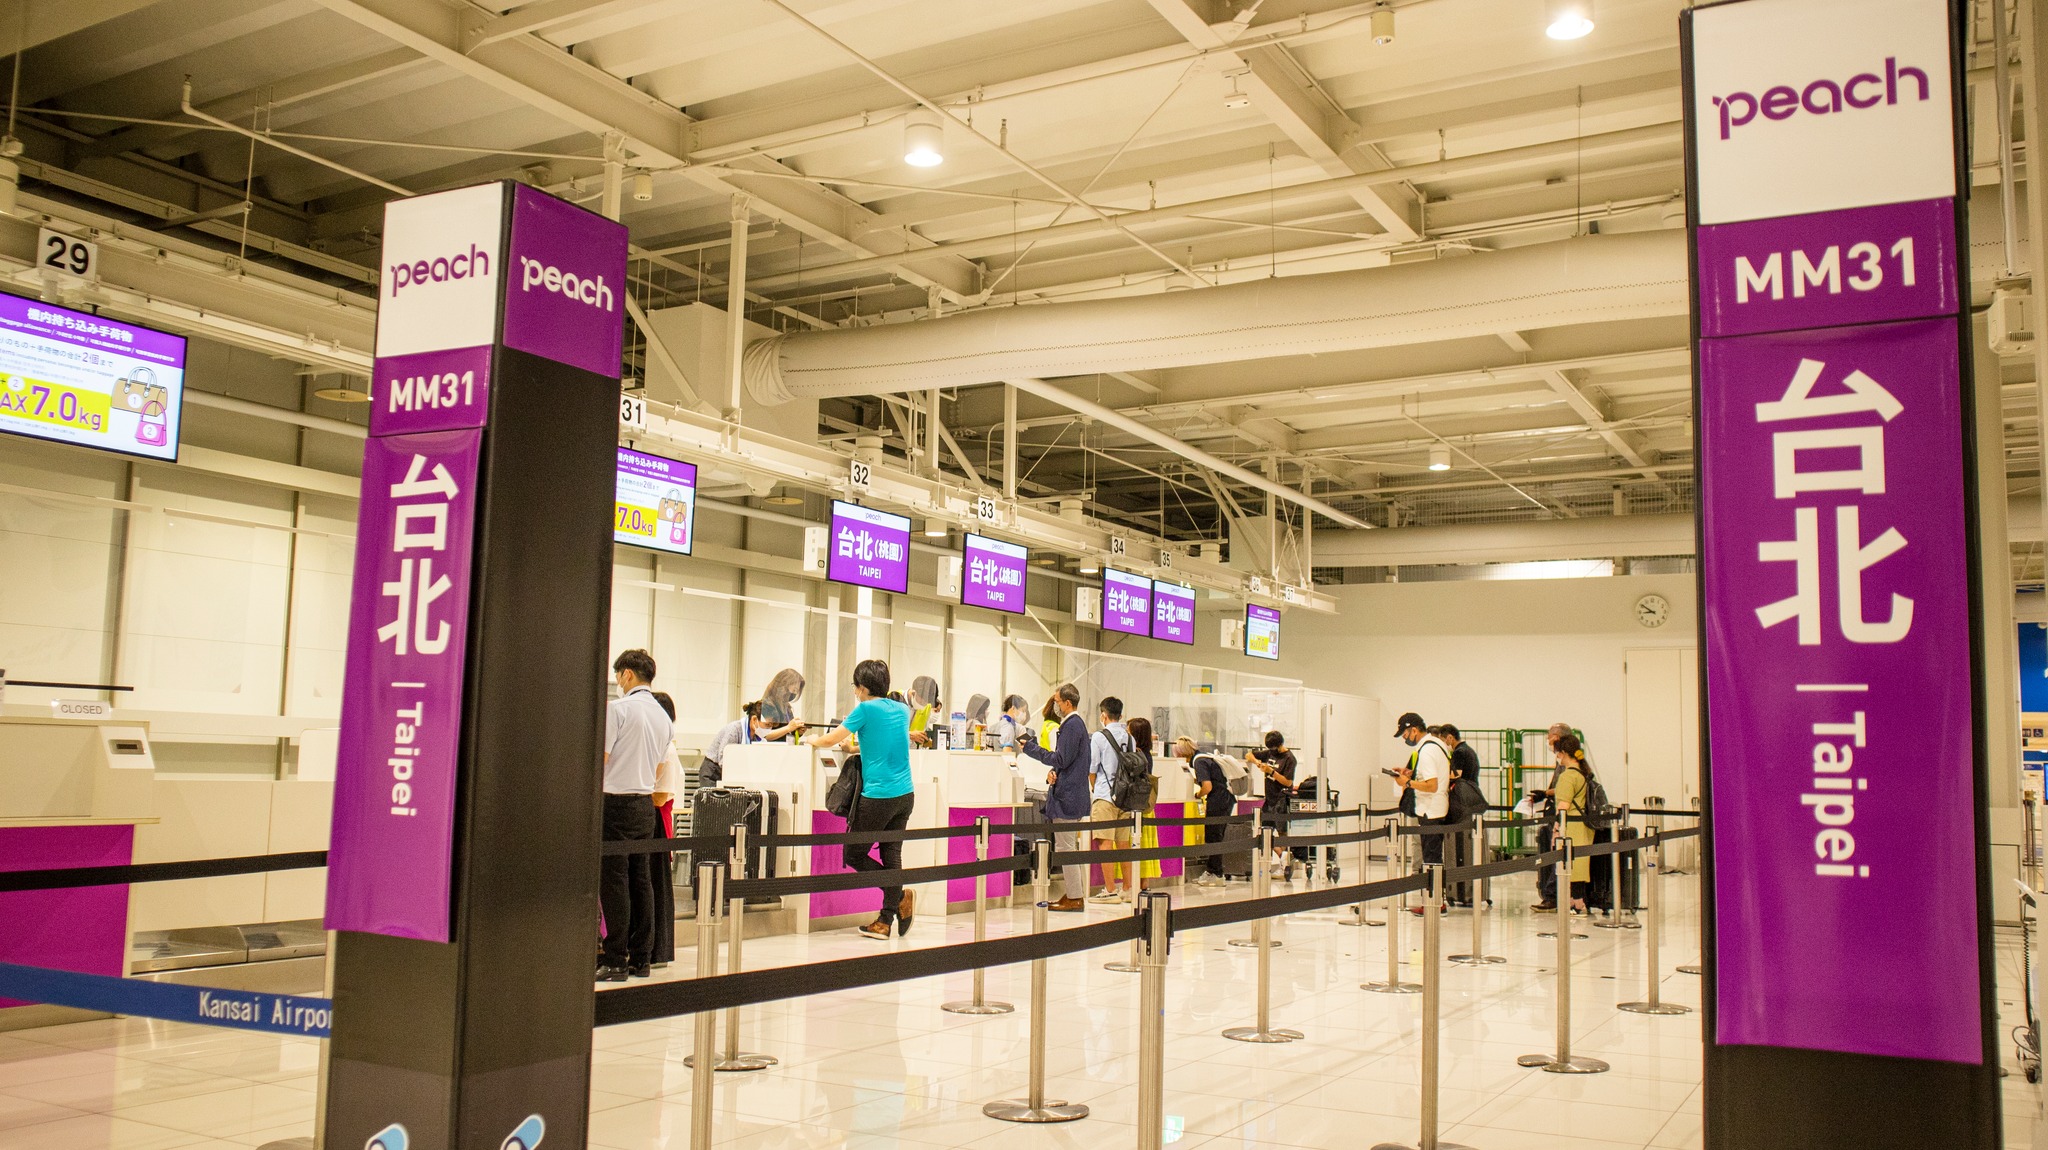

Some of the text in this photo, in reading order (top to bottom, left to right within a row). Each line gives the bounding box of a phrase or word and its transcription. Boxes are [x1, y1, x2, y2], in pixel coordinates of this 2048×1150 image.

[1712, 56, 1930, 140] peach
[45, 236, 89, 275] 29
[391, 243, 489, 297] peach
[1735, 237, 1916, 304] MM31
[520, 255, 613, 312] peach
[27, 307, 133, 343] 機内持ち込み手荷物
[389, 370, 474, 413] MM31
[622, 399, 641, 424] 31
[853, 464, 869, 485] 32
[980, 500, 994, 519] 33
[1755, 357, 1914, 646] 台北
[377, 453, 460, 656] 台北
[1114, 539, 1124, 554] 34
[1162, 551, 1171, 567] 35
[858, 565, 882, 579] TAIPEI
[986, 590, 1005, 602] TAIPEI
[1120, 616, 1135, 627] TAIPEI
[1167, 626, 1180, 636] TAIPEI
[61, 704, 103, 715] CLOSED
[388, 701, 424, 817] Taipei
[1801, 711, 1870, 877] Taipei
[199, 991, 259, 1022] Kansai
